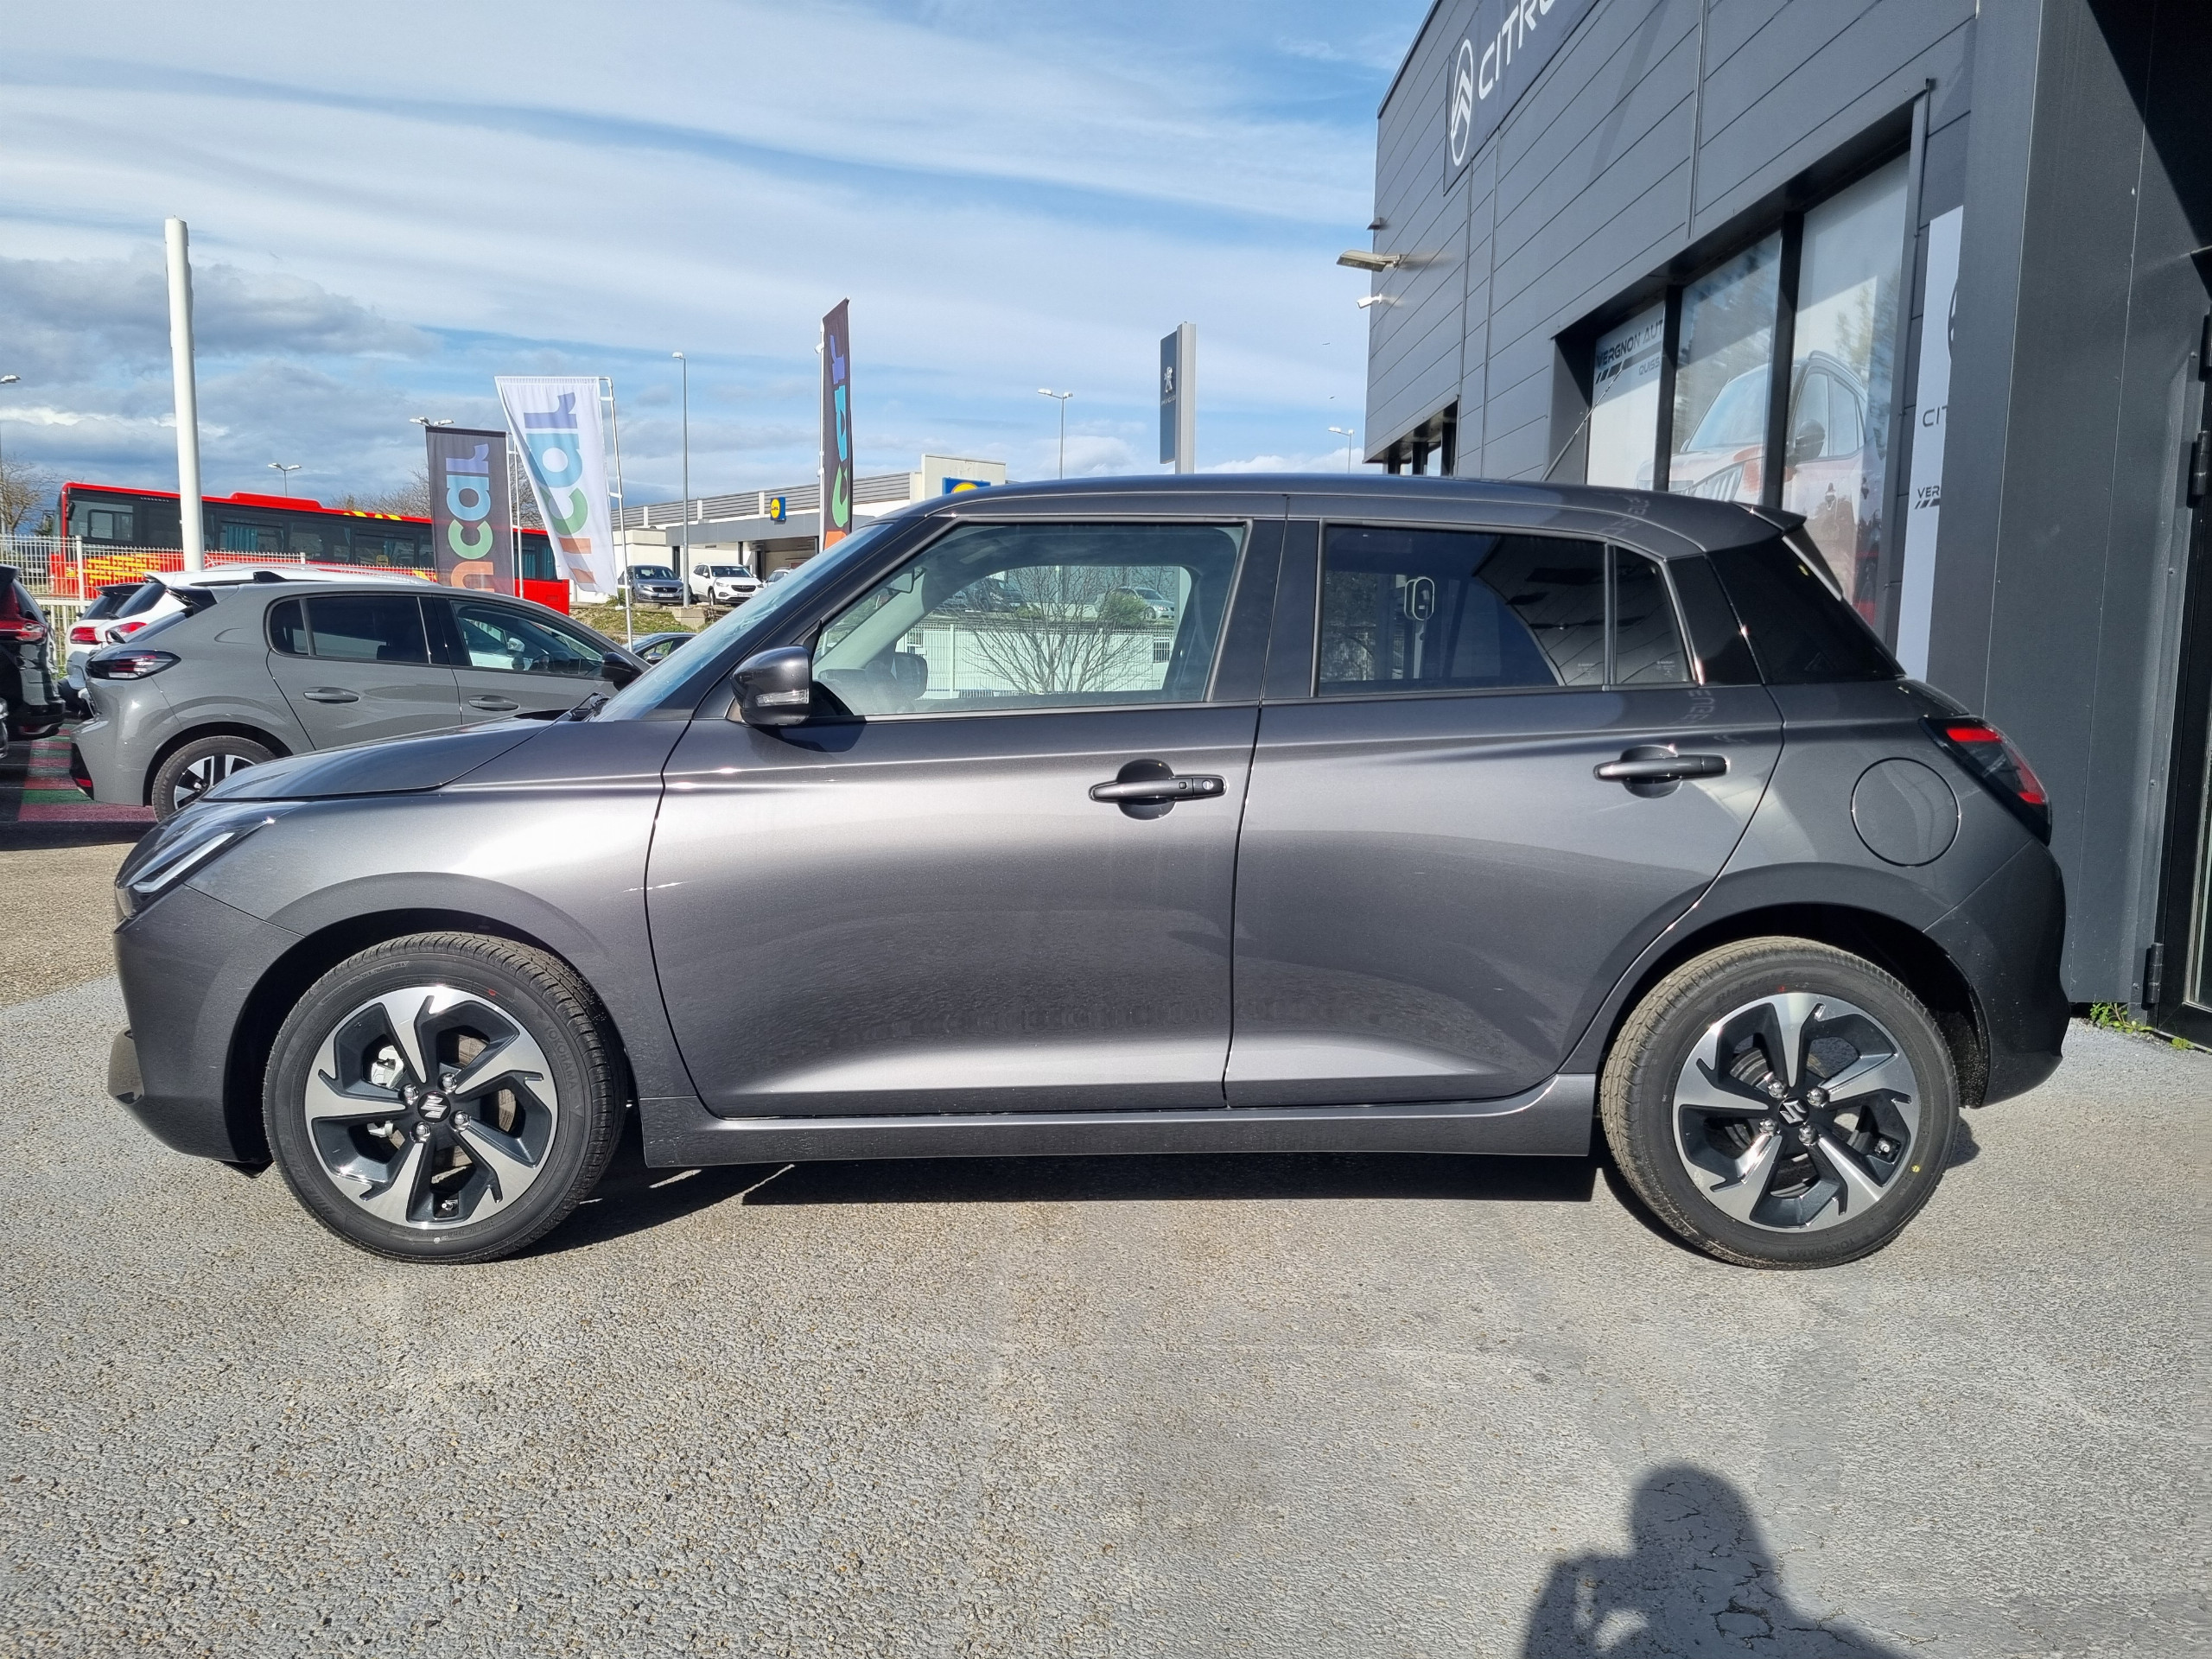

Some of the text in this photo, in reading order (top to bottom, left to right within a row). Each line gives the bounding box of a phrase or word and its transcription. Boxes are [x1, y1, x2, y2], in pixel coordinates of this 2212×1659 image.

[1596, 332, 1641, 368] VERGNON
[1917, 486, 1940, 499] VER
[544, 1025, 577, 1089] YOKOHAMA
